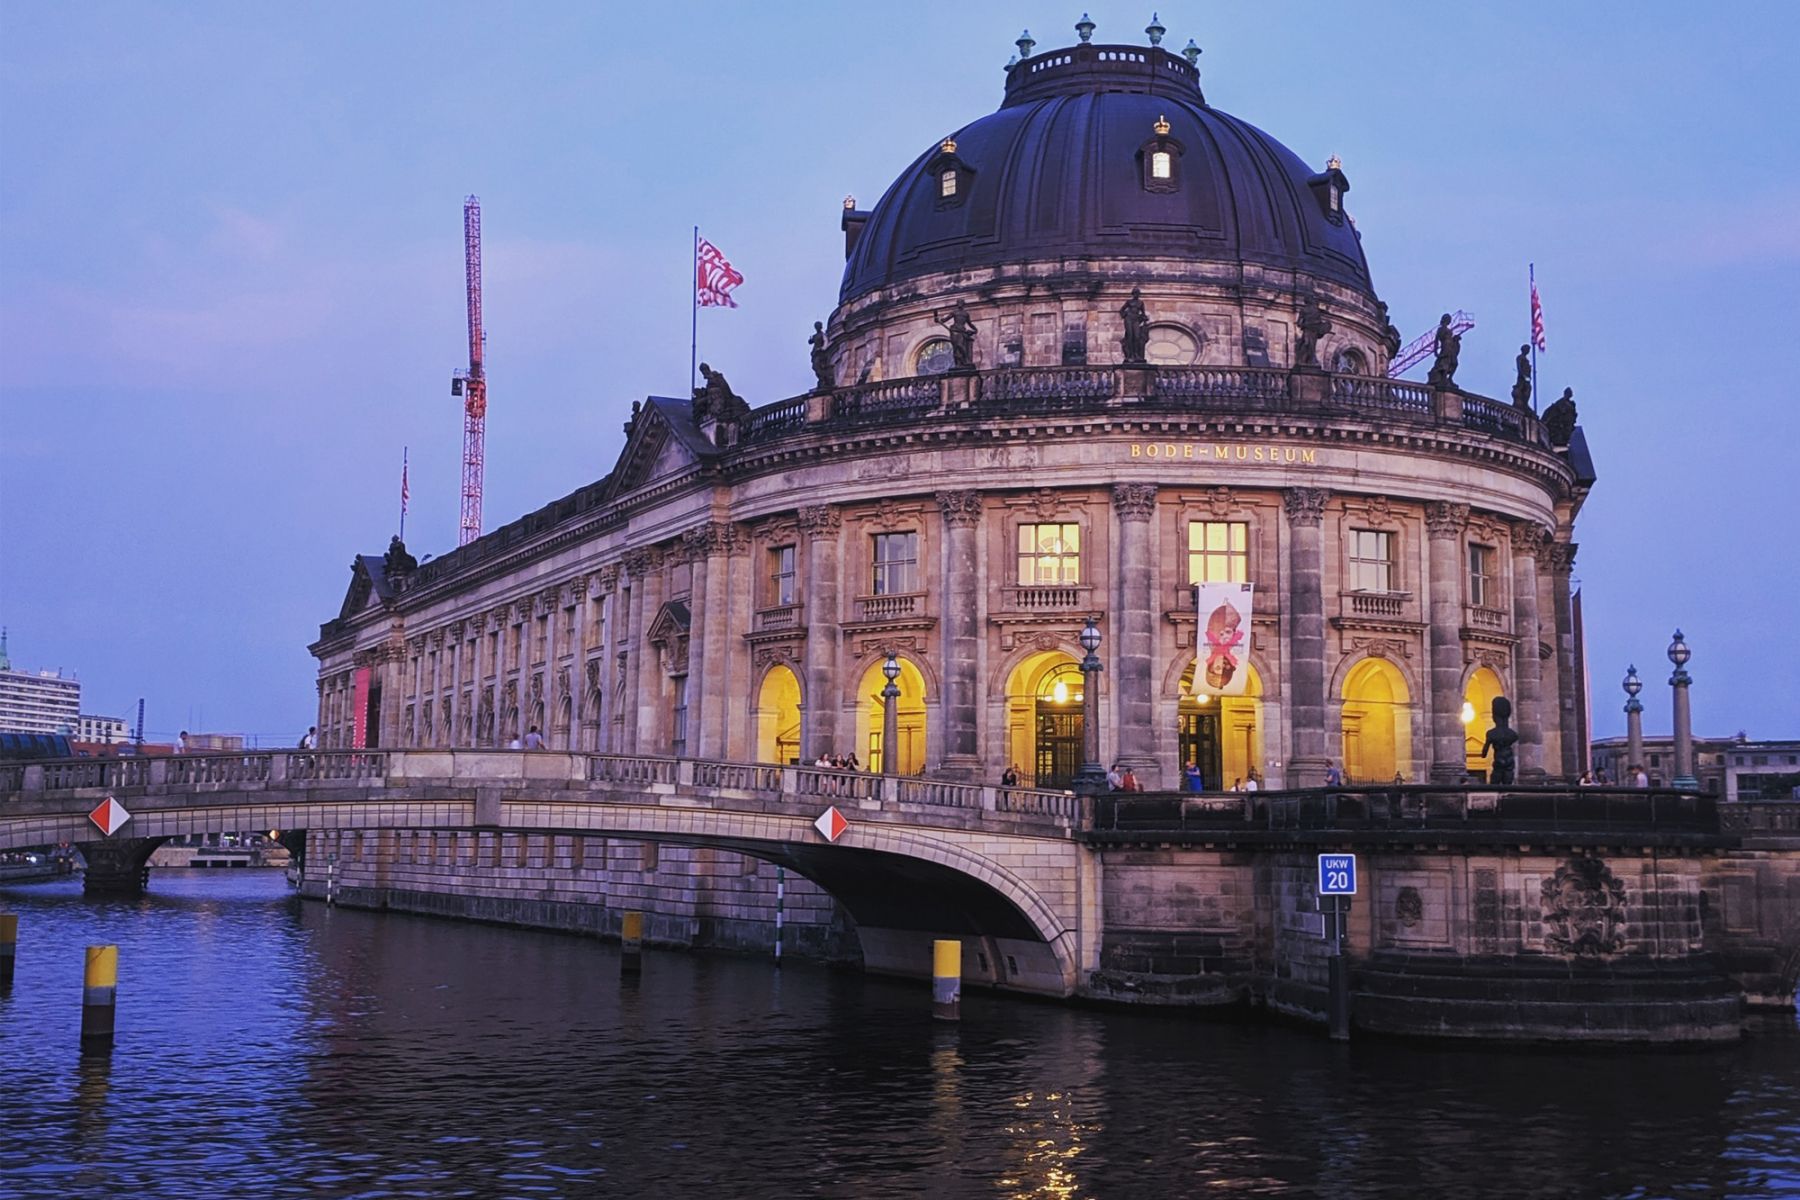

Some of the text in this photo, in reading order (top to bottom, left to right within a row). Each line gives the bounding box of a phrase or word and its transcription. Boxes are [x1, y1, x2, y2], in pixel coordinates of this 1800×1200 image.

[1131, 444, 1315, 463] BODE-MUSEUM
[1325, 859, 1349, 869] UKW
[1327, 871, 1348, 889] 20
